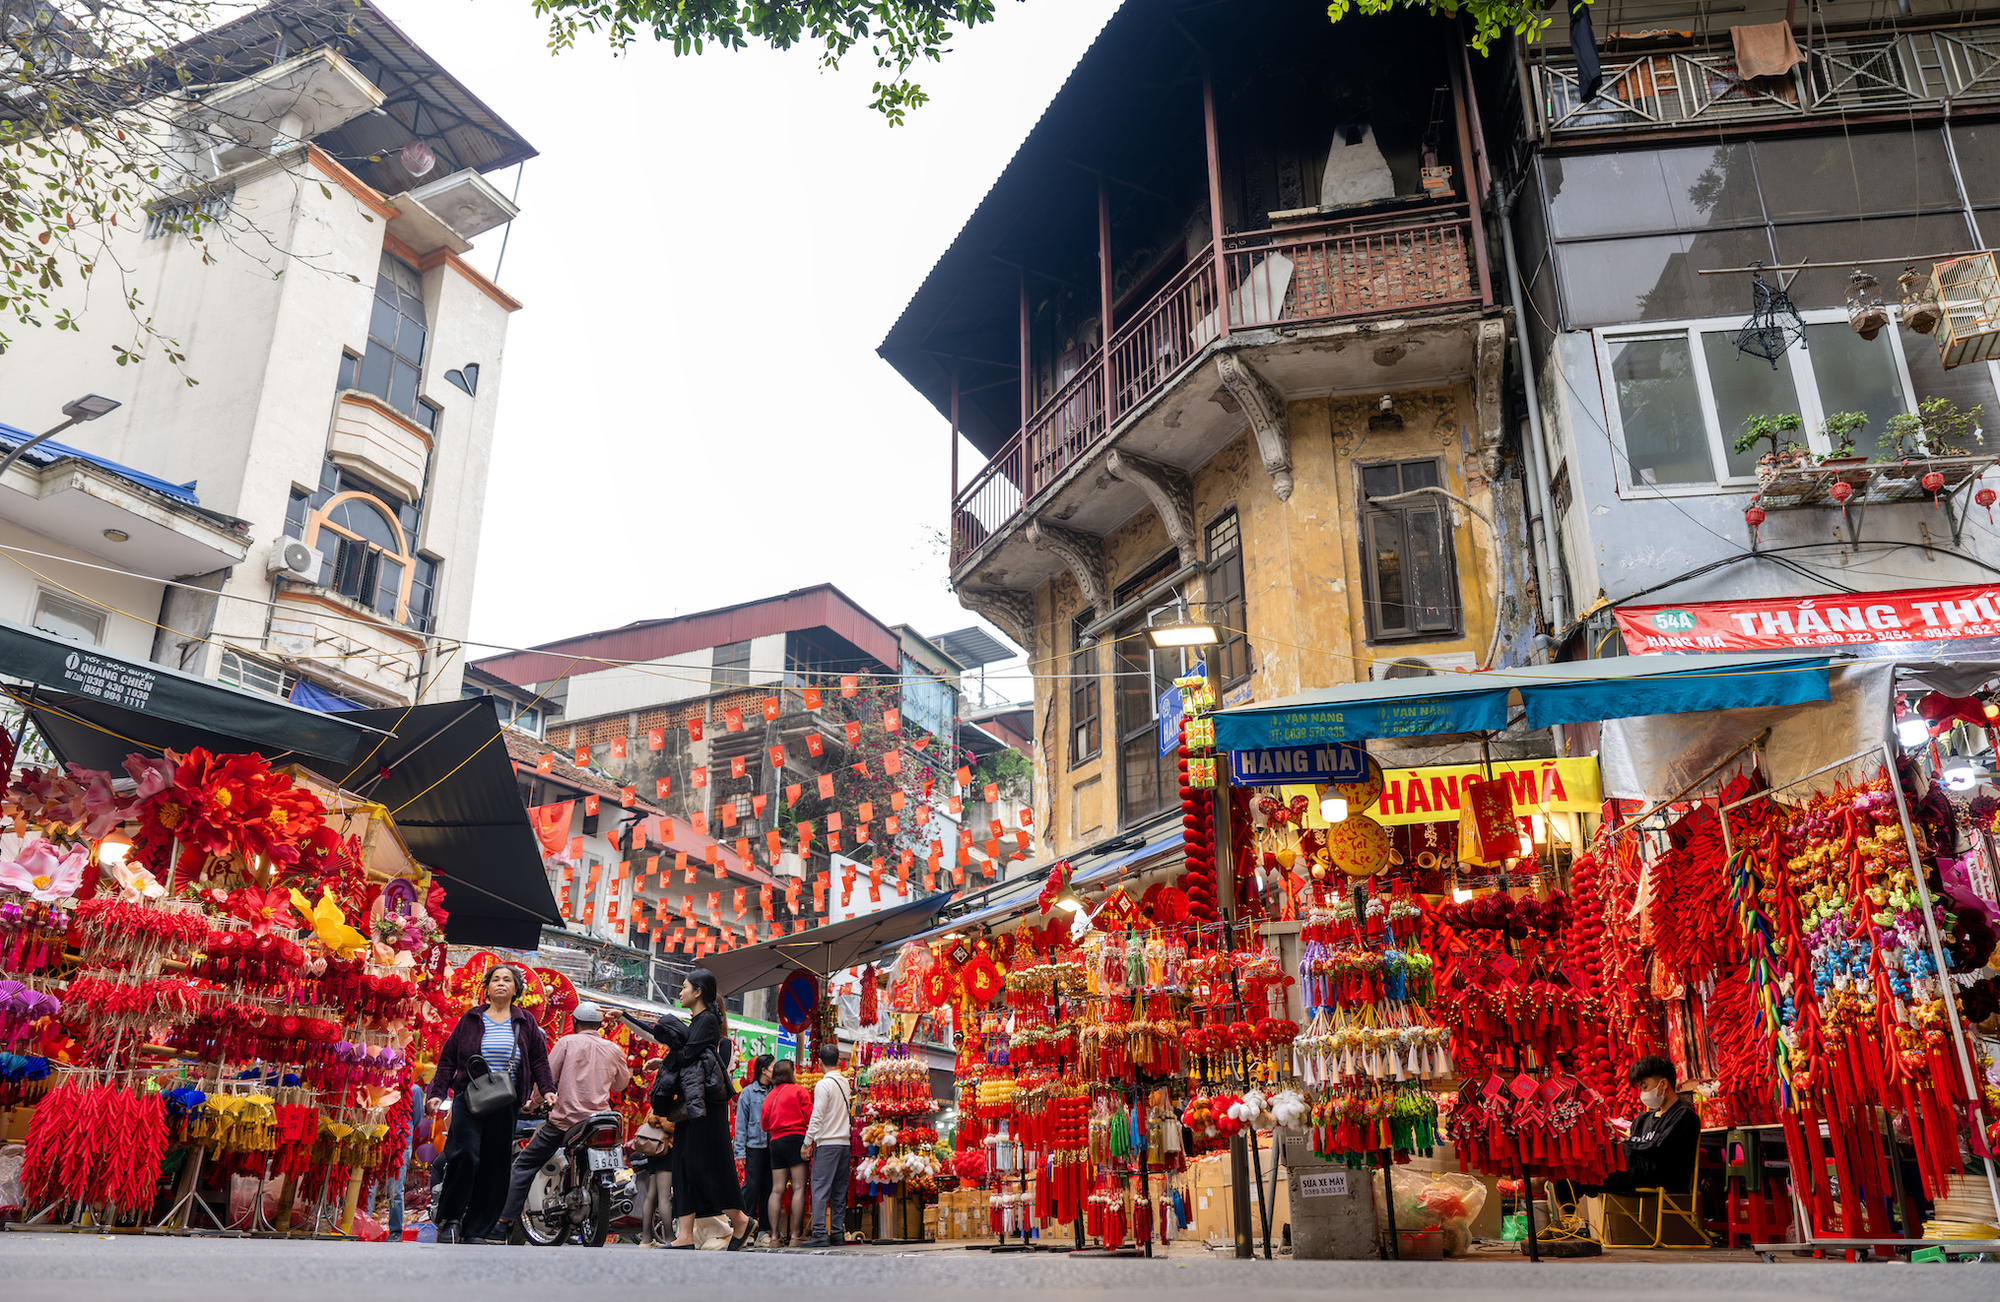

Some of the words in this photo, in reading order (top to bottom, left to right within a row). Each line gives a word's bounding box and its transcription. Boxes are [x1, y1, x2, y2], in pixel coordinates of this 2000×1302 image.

[1655, 613, 1693, 629] 54A
[1731, 600, 1902, 636] THẮNG
[1646, 634, 1694, 648] HÀNG
[1695, 633, 1727, 648] MÃ
[1817, 634, 1844, 645] 090
[1846, 632, 1874, 642] 322
[1876, 630, 1912, 640] 5454
[1923, 627, 1961, 639] 0945
[1964, 624, 1993, 635] 452
[80, 663, 118, 682] QUANG
[86, 675, 105, 687] 036
[106, 681, 124, 693] 430
[126, 687, 150, 700] 1038
[83, 684, 102, 696] 056
[103, 690, 121, 701] 994
[124, 697, 146, 709] 1111
[1283, 713, 1307, 726] VẠN
[1393, 707, 1416, 719] VẠN
[1284, 727, 1307, 740] 0839
[1309, 727, 1325, 738] 570
[1328, 726, 1345, 738] 335
[1500, 761, 1568, 806] MÃ
[1302, 1177, 1318, 1188] SỬA
[1318, 1178, 1327, 1187] XE
[1329, 1176, 1345, 1186] MÁY
